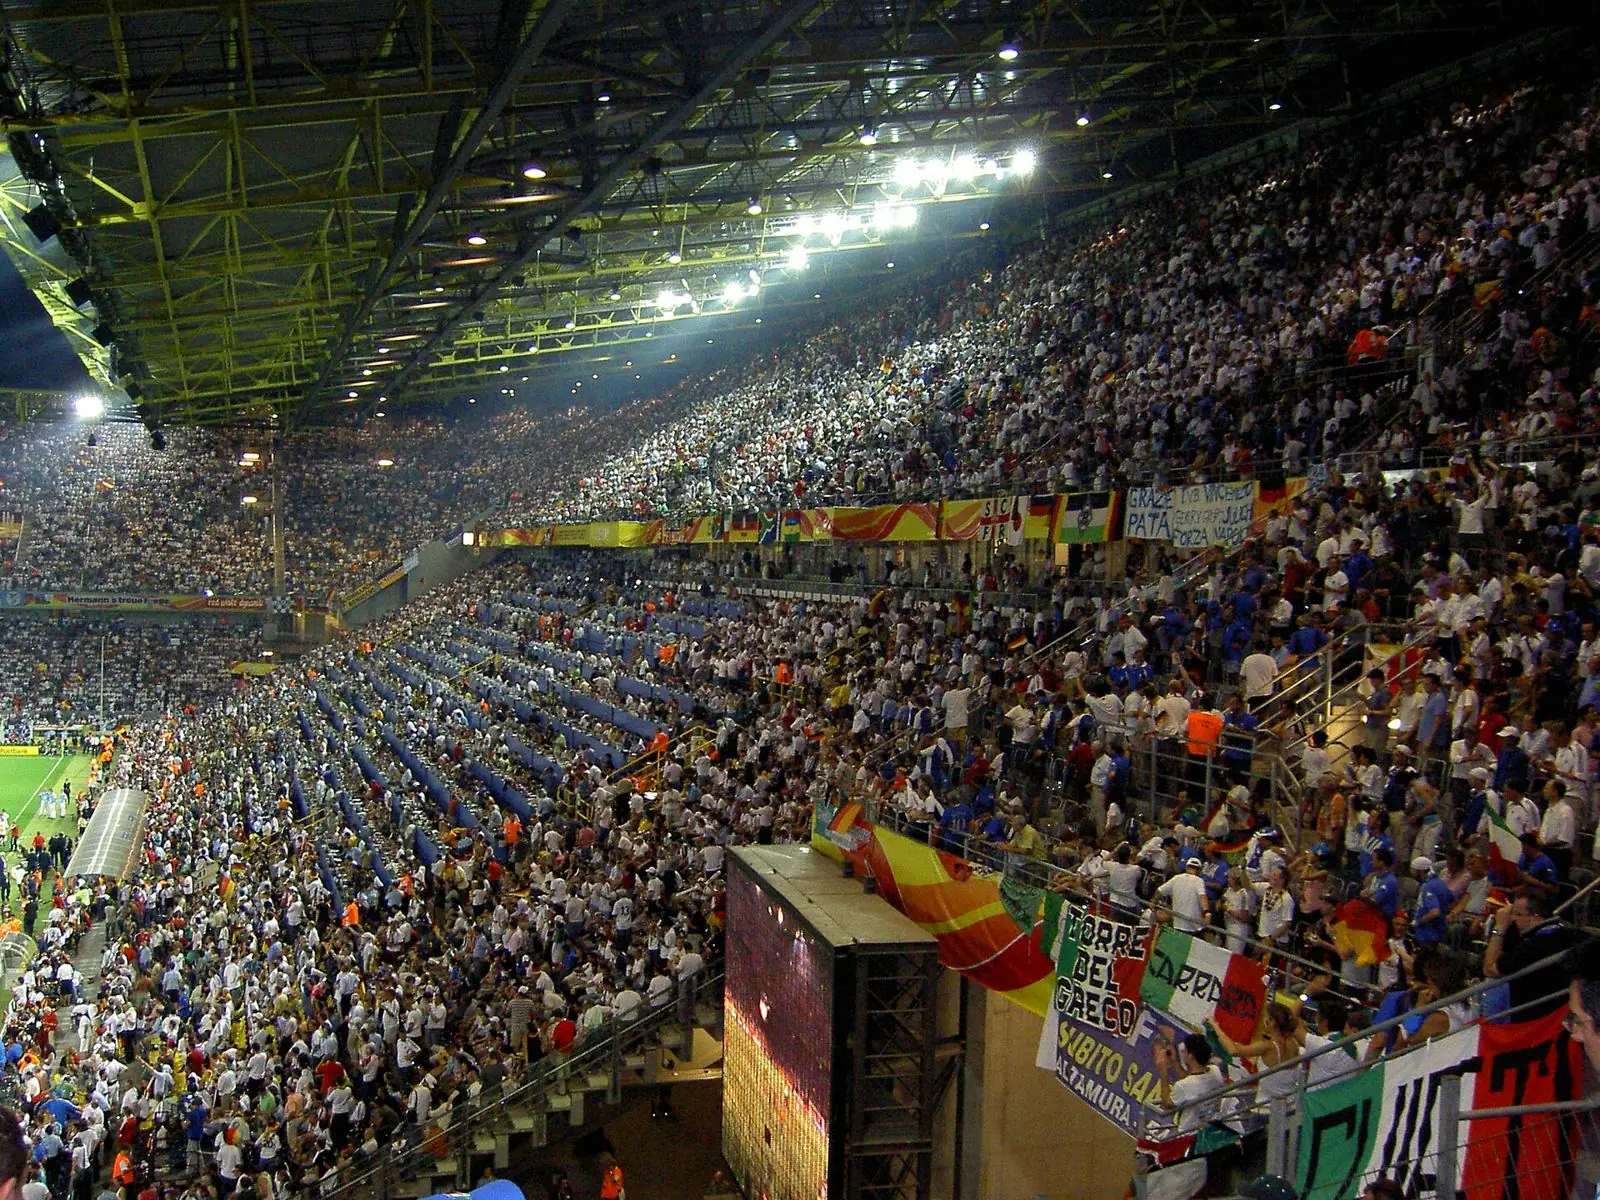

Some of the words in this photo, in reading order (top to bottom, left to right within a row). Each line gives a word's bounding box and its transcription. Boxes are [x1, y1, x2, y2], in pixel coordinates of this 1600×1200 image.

[1068, 903, 1151, 960] TORRE
[1072, 944, 1120, 995] DEL
[1054, 975, 1137, 1037] GRECO
[1058, 1021, 1123, 1084] SUBITO
[1056, 1055, 1131, 1127] ALTAMURA
